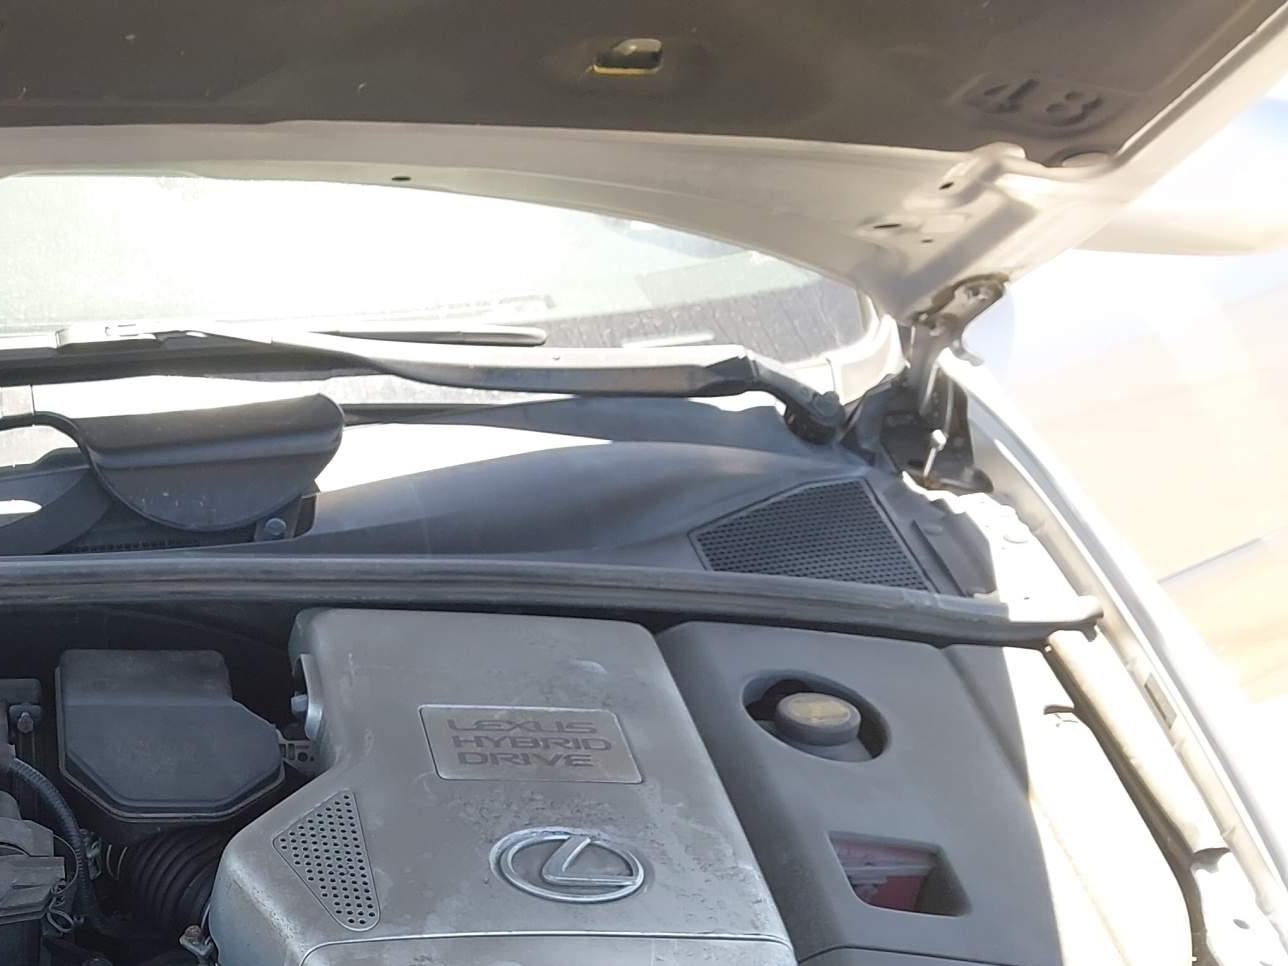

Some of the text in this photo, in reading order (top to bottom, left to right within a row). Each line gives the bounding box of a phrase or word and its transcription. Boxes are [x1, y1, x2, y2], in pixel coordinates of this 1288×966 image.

[447, 718, 598, 735] LEXUS
[451, 734, 613, 752] HYBRID
[457, 751, 595, 768] DRIVE
